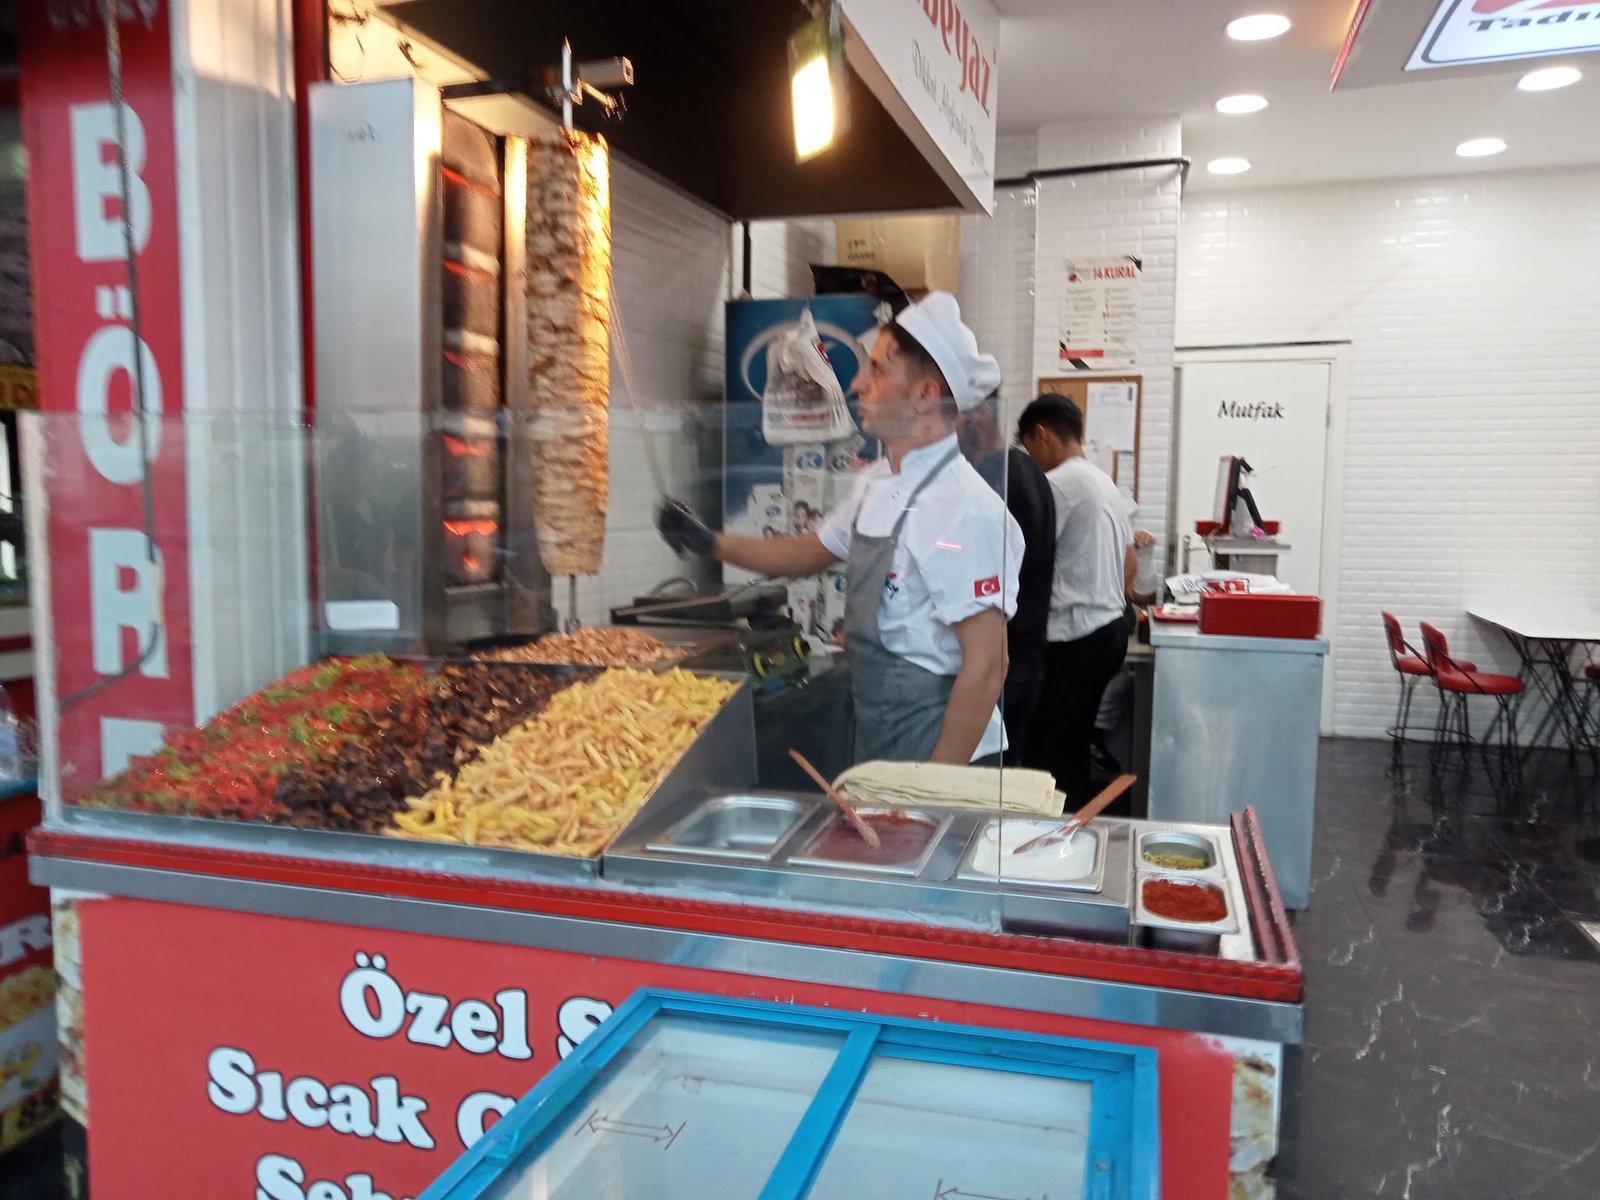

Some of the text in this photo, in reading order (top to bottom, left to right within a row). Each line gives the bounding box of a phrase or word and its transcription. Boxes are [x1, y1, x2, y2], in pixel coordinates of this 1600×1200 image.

[1217, 400, 1284, 422] Mutfak
[340, 951, 532, 1060] Özel
[207, 1046, 436, 1149] Sıcak
